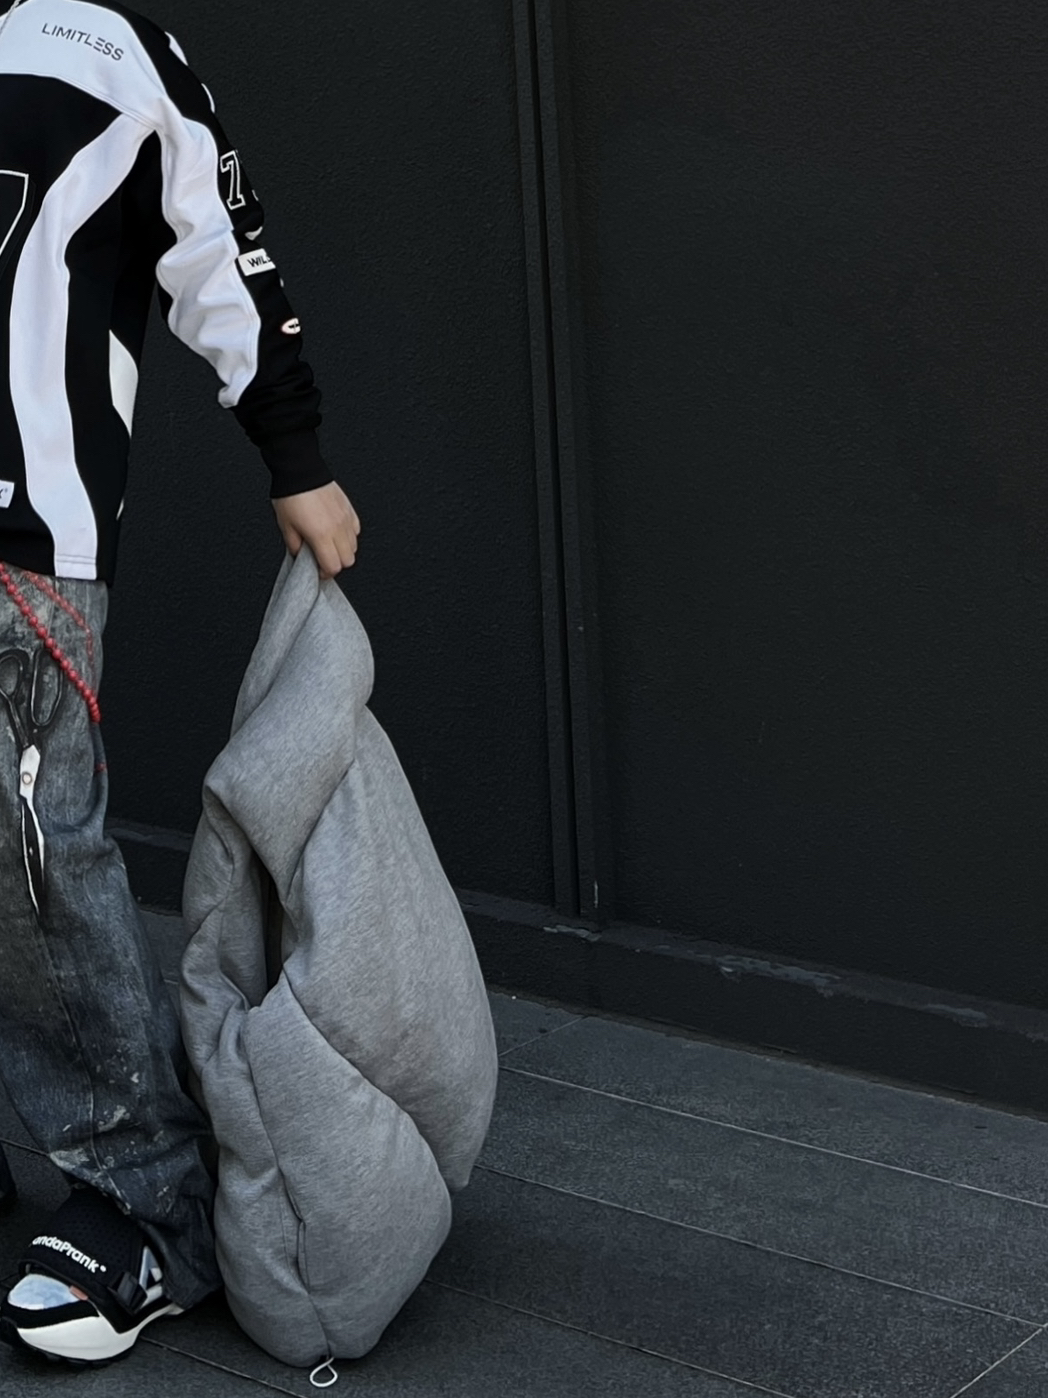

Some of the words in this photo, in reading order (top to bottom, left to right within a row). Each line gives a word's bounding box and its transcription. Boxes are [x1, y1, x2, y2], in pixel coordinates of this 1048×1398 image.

[41, 23, 124, 61] LIMITLESS
[220, 150, 246, 210] 7
[31, 1235, 100, 1273] andaPrank
